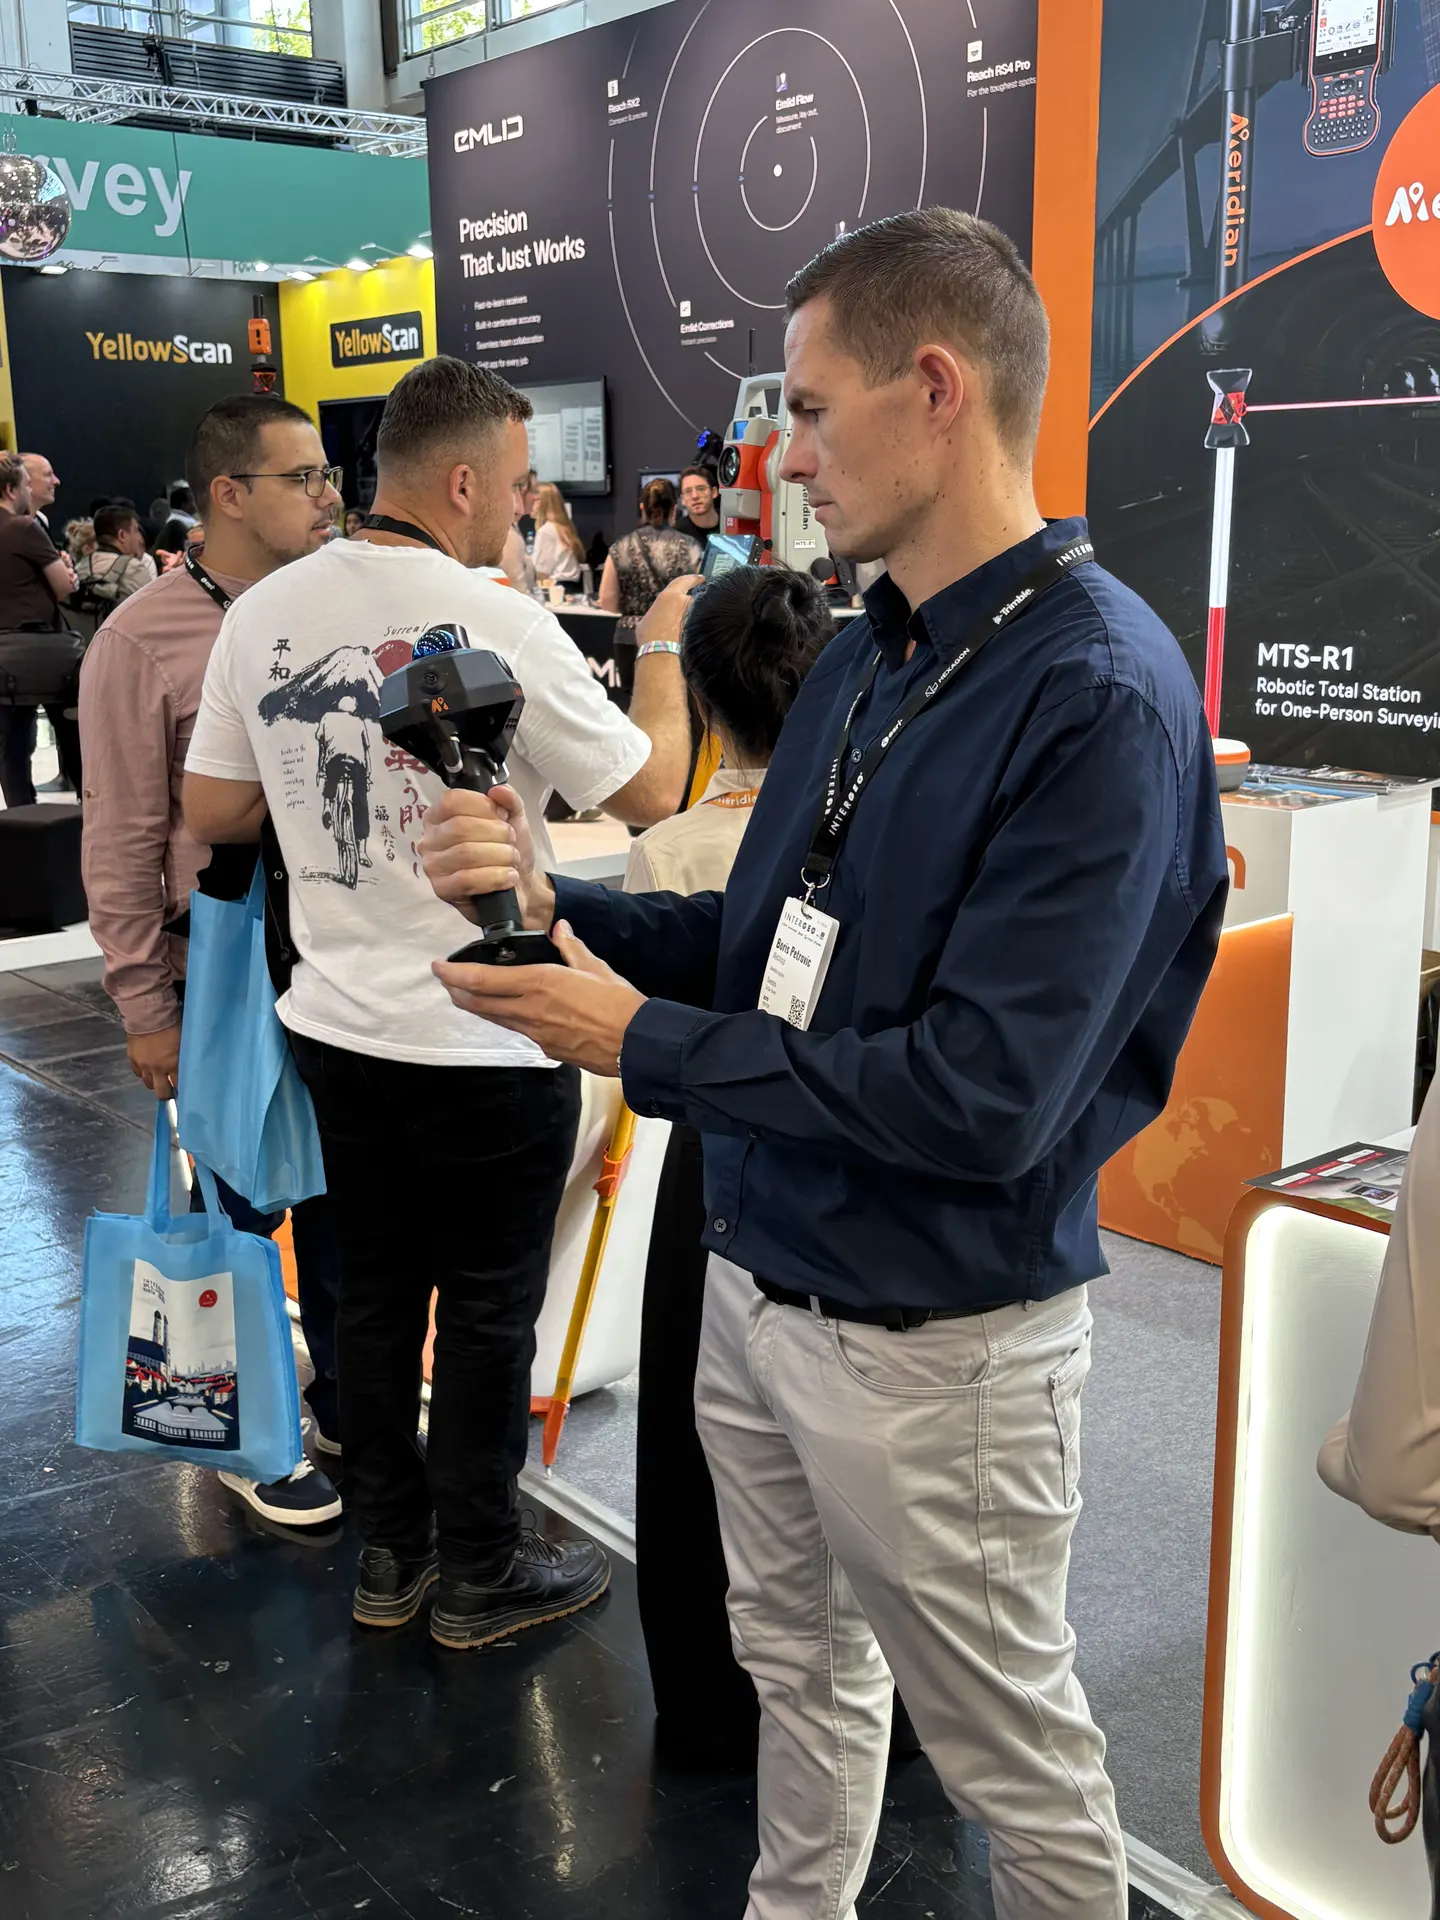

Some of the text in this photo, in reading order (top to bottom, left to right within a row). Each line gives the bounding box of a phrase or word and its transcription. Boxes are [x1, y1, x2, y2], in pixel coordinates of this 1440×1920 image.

[967, 60, 1031, 83] Reach RS4 Pro
[1223, 112, 1250, 268] Meridian
[459, 208, 529, 244] Precision
[459, 234, 586, 279] That Just Works
[85, 331, 233, 365] YellowScan
[335, 323, 420, 359] YellowScan
[801, 487, 811, 531] eridian
[268, 638, 291, 681] 平和
[937, 647, 971, 684] HEXAGON
[1257, 642, 1354, 672] MTS-R1
[1256, 676, 1422, 704] Robotic Total Station
[1255, 698, 1278, 716] for
[1280, 700, 1374, 724] One-Person
[784, 911, 816, 935] INTERGEO
[775, 937, 791, 956] Boris
[789, 946, 813, 969] Petrovic
